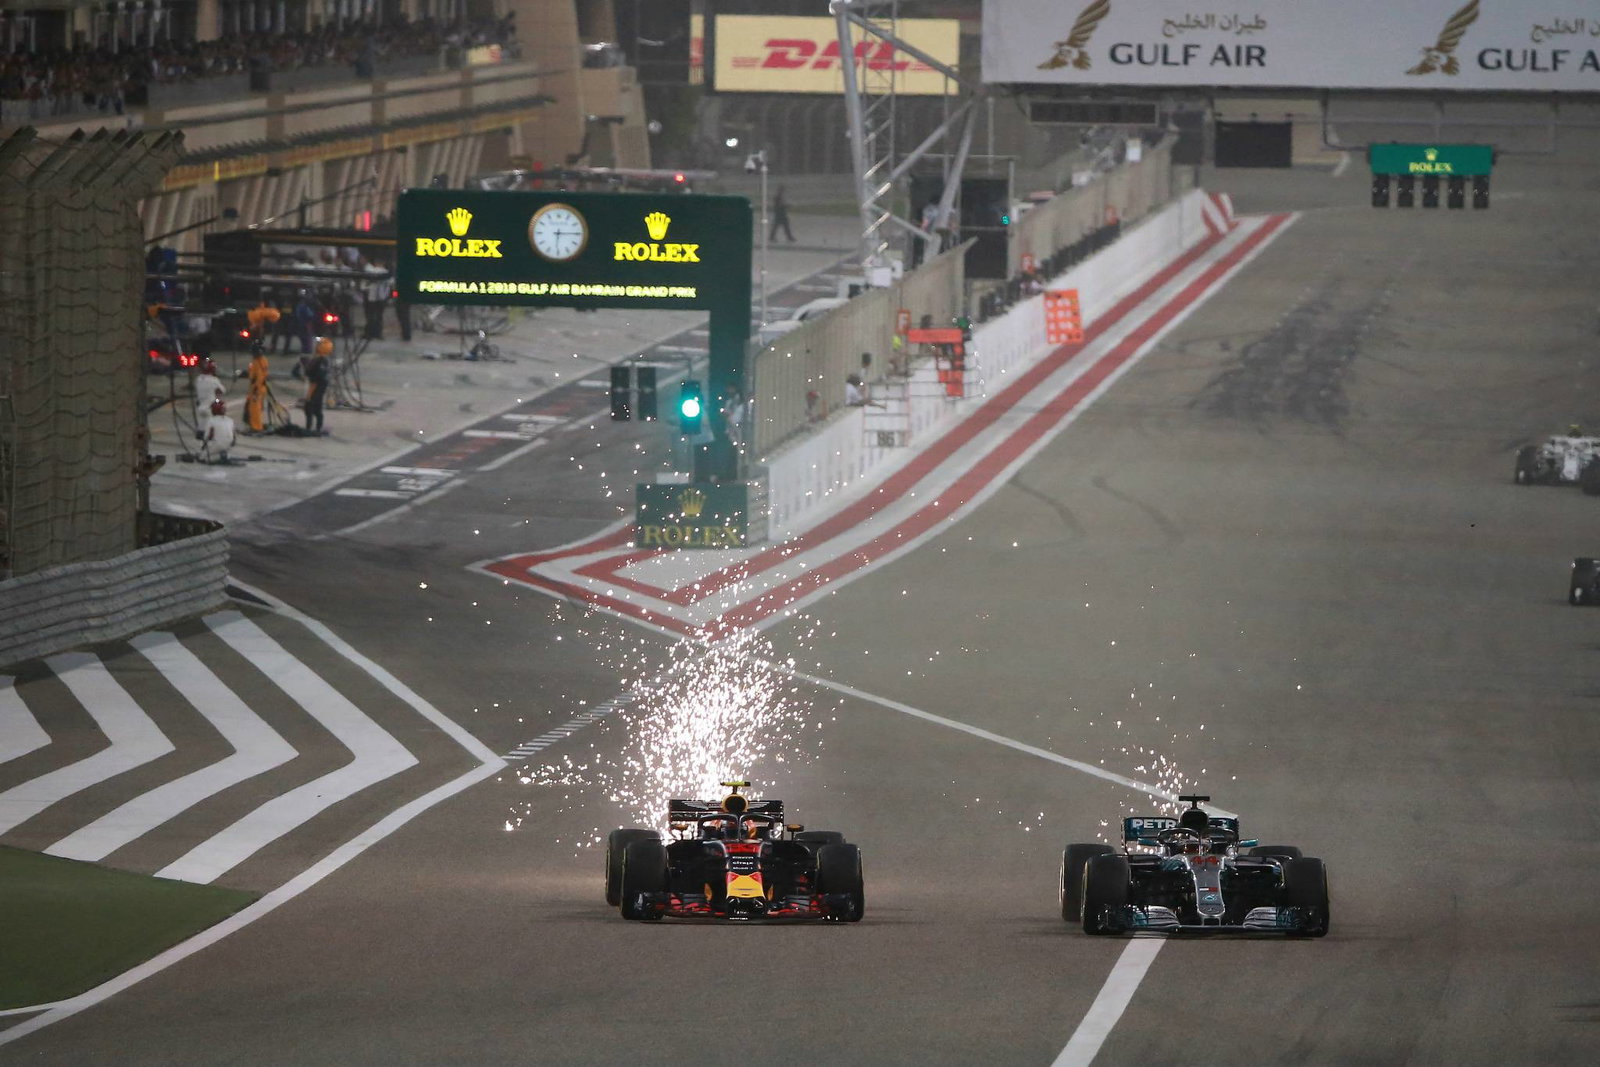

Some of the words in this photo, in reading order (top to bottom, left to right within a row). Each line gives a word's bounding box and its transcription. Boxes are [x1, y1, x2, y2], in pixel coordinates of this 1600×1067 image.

[1109, 42, 1200, 66] GULF
[1209, 44, 1267, 67] AIR
[1478, 48, 1570, 72] GULF
[1409, 161, 1453, 173] ROLEX
[415, 237, 503, 258] ROLEX
[613, 242, 701, 263] ROLEX
[419, 280, 478, 293] FORMULA
[479, 281, 487, 294] 1
[517, 283, 549, 294] GULF
[549, 283, 570, 296] AIR
[570, 284, 625, 296] BAHRAIN
[625, 285, 668, 298] GRAND
[668, 286, 697, 298] PRIX
[643, 525, 741, 545] ROLEX
